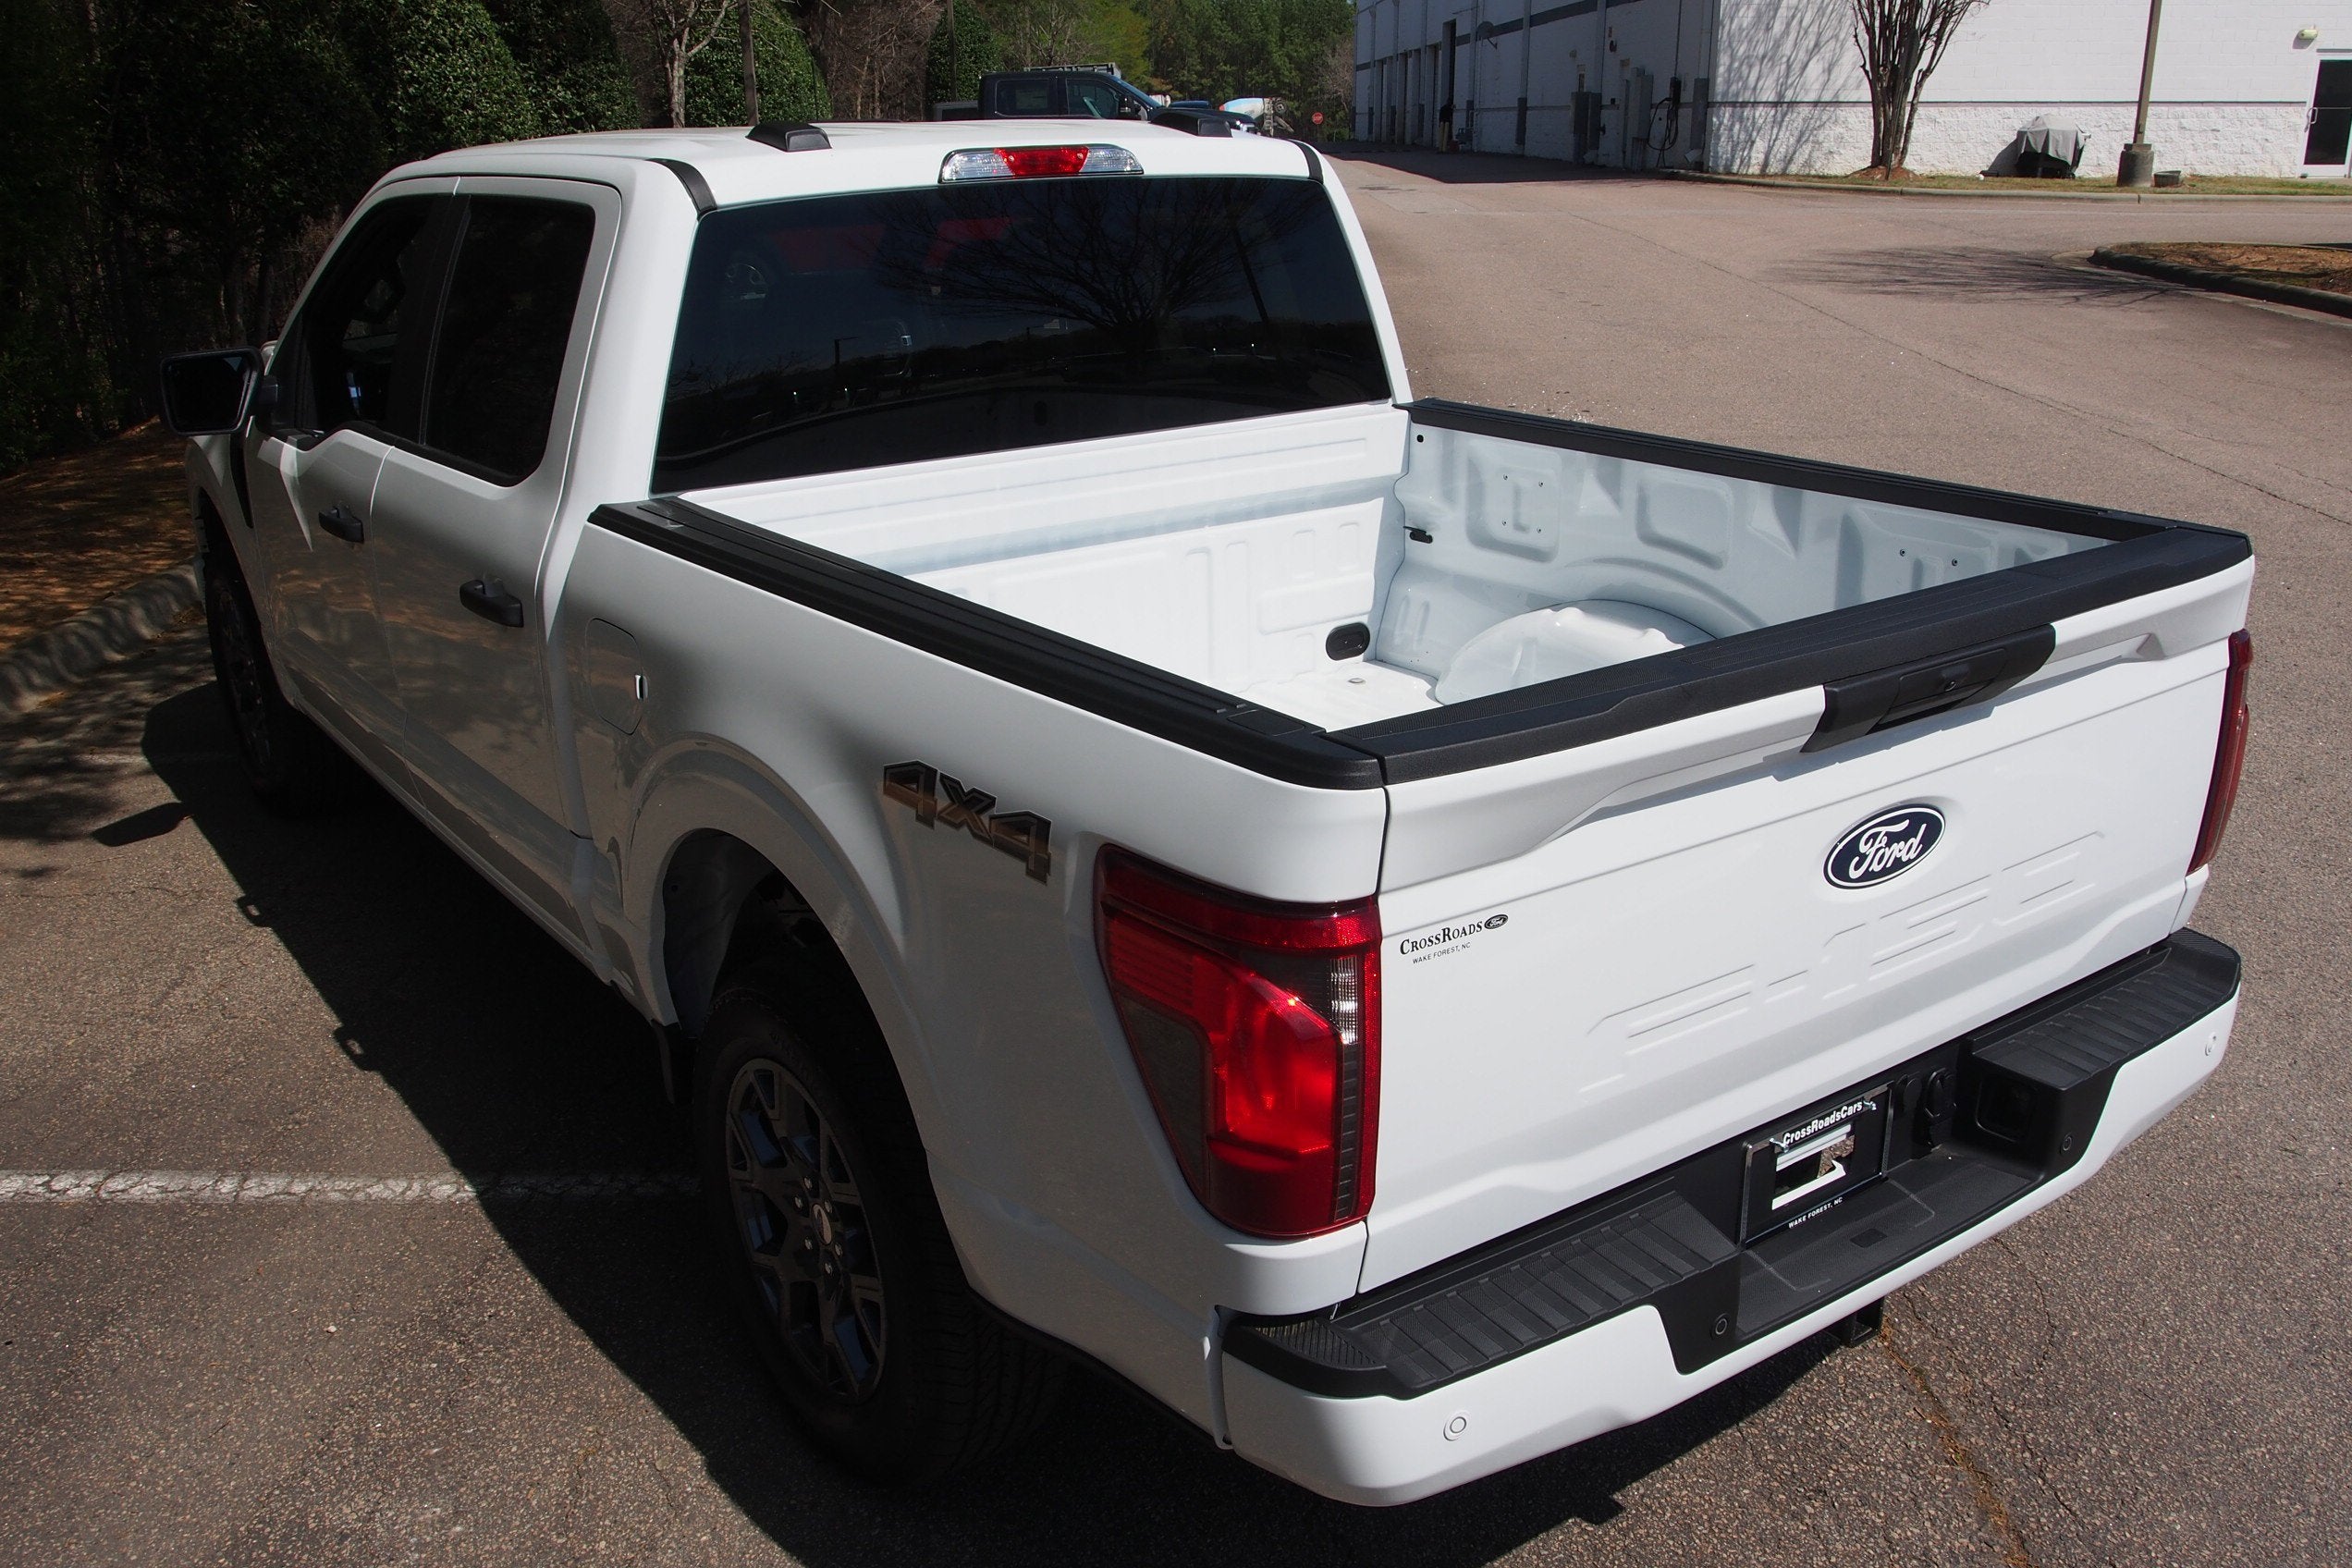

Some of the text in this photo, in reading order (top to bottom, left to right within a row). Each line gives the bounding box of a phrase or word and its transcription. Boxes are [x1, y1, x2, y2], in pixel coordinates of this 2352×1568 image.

[883, 759, 1052, 886] 4x4
[1849, 819, 1927, 879] Ford
[1412, 942, 1471, 964] WAKE FOREST, NC
[1782, 1101, 1863, 1146] CrossRoadsCars
[1788, 1196, 1844, 1229] WAKE FOREST, NC
